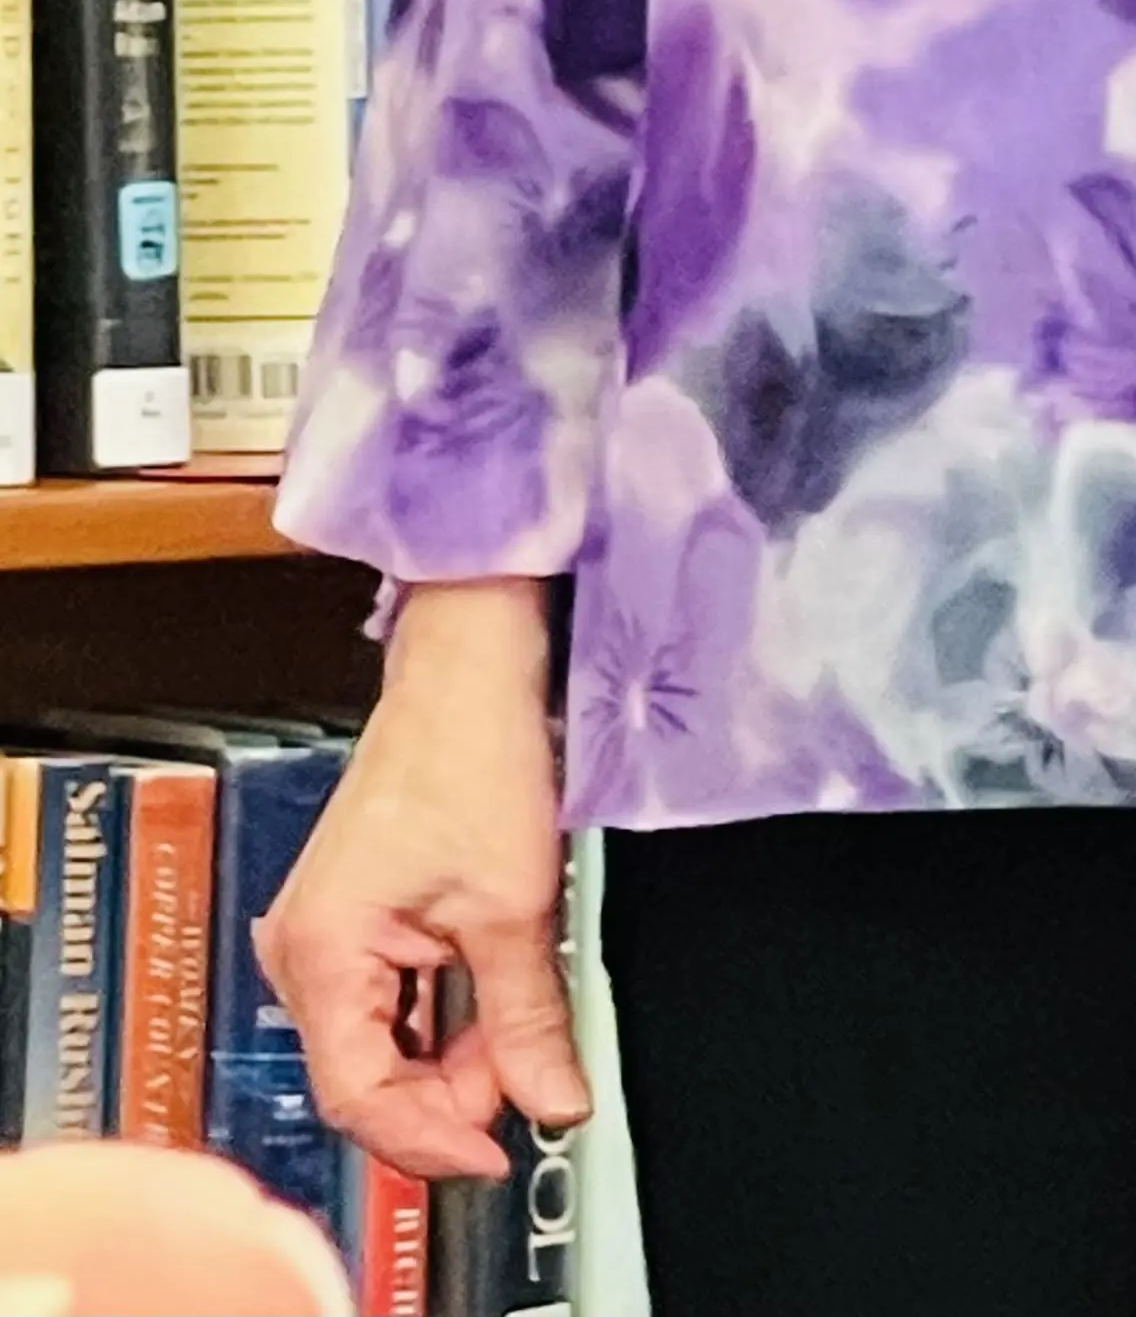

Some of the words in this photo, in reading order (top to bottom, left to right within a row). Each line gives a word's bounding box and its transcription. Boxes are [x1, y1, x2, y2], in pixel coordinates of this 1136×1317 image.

[60, 781, 107, 975] Salman
[149, 844, 178, 978] COPPER
[176, 925, 203, 1061] WOMEN
